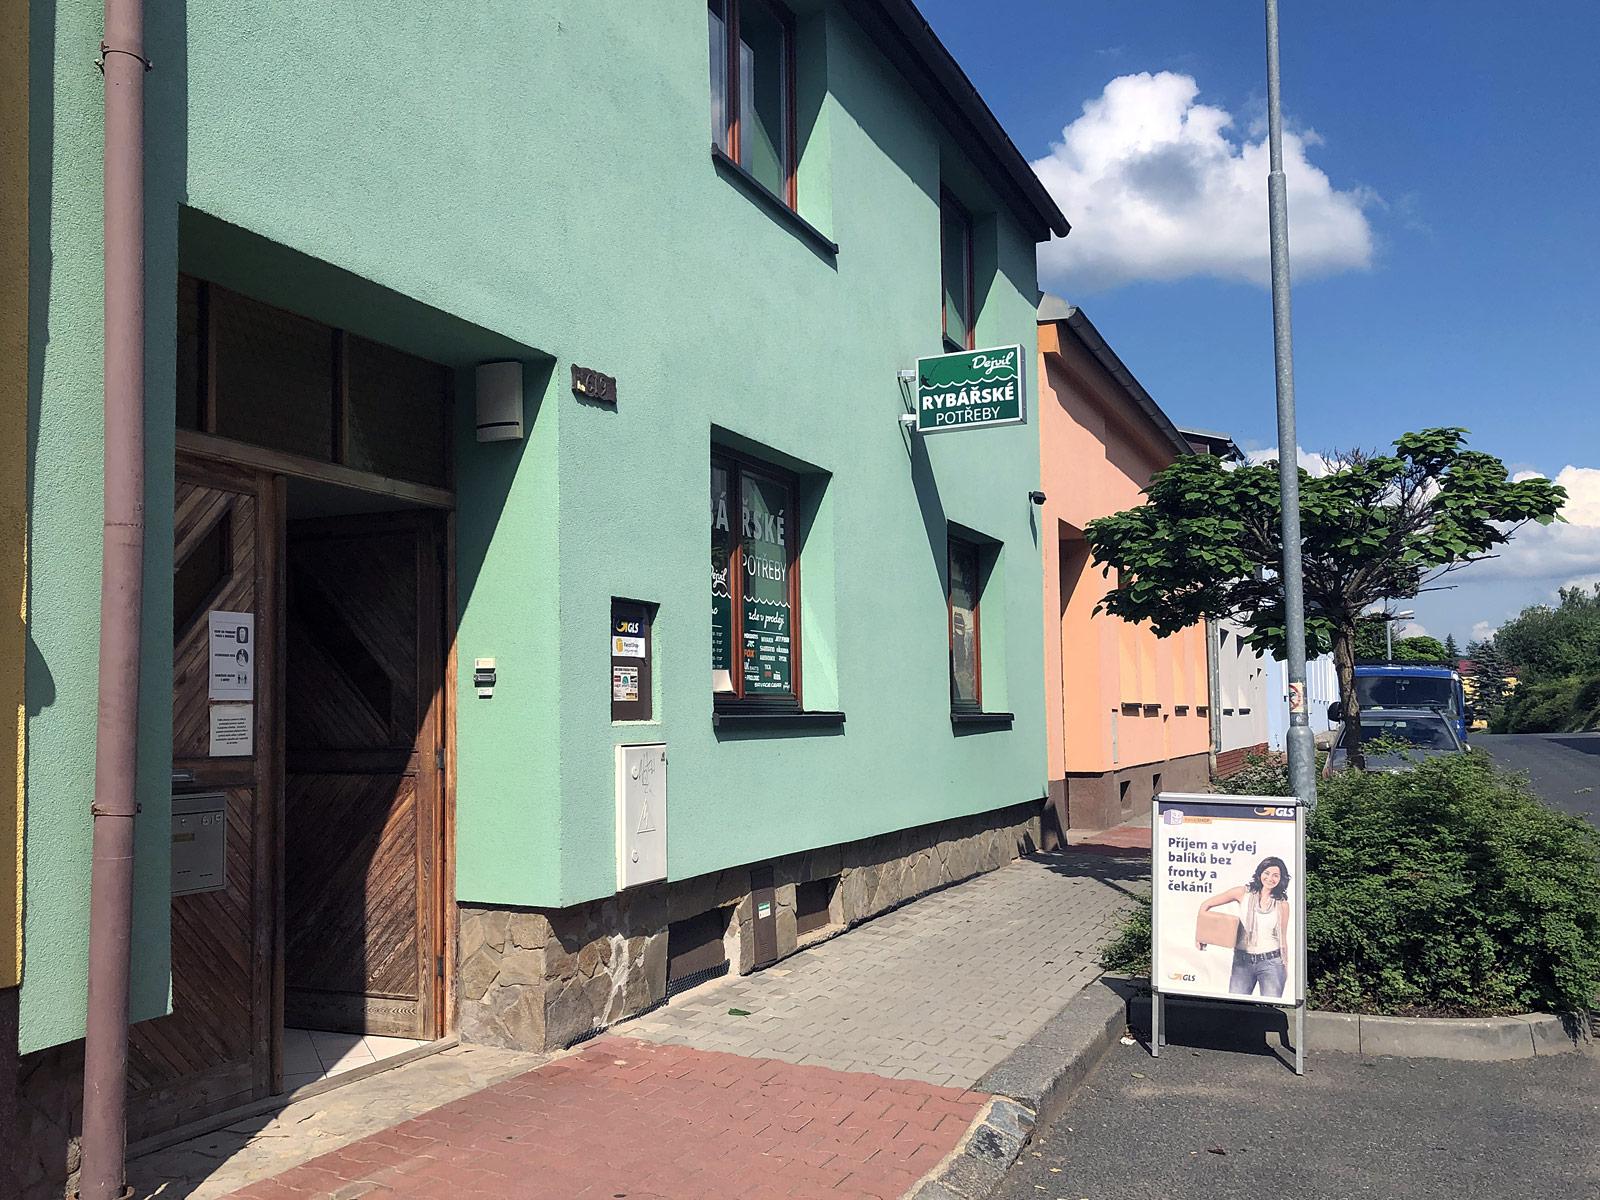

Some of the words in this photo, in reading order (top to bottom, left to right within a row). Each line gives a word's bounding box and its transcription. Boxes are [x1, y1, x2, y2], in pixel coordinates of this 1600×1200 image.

[972, 351, 1014, 374] Dejvil
[922, 382, 1014, 410] RYBÁŘSKÉ
[936, 406, 1000, 425] POTŘEBY
[628, 622, 639, 633] GLS
[1275, 807, 1295, 817] GLS
[1168, 837, 1207, 851] Příjem
[1211, 842, 1219, 850] a
[1222, 840, 1257, 854] výdej
[1168, 851, 1207, 864] balíků
[1210, 853, 1232, 865] bez
[1168, 866, 1206, 881] fronty
[1210, 871, 1218, 879] a
[1168, 880, 1213, 893] čekání!
[1182, 974, 1196, 982] GLS
